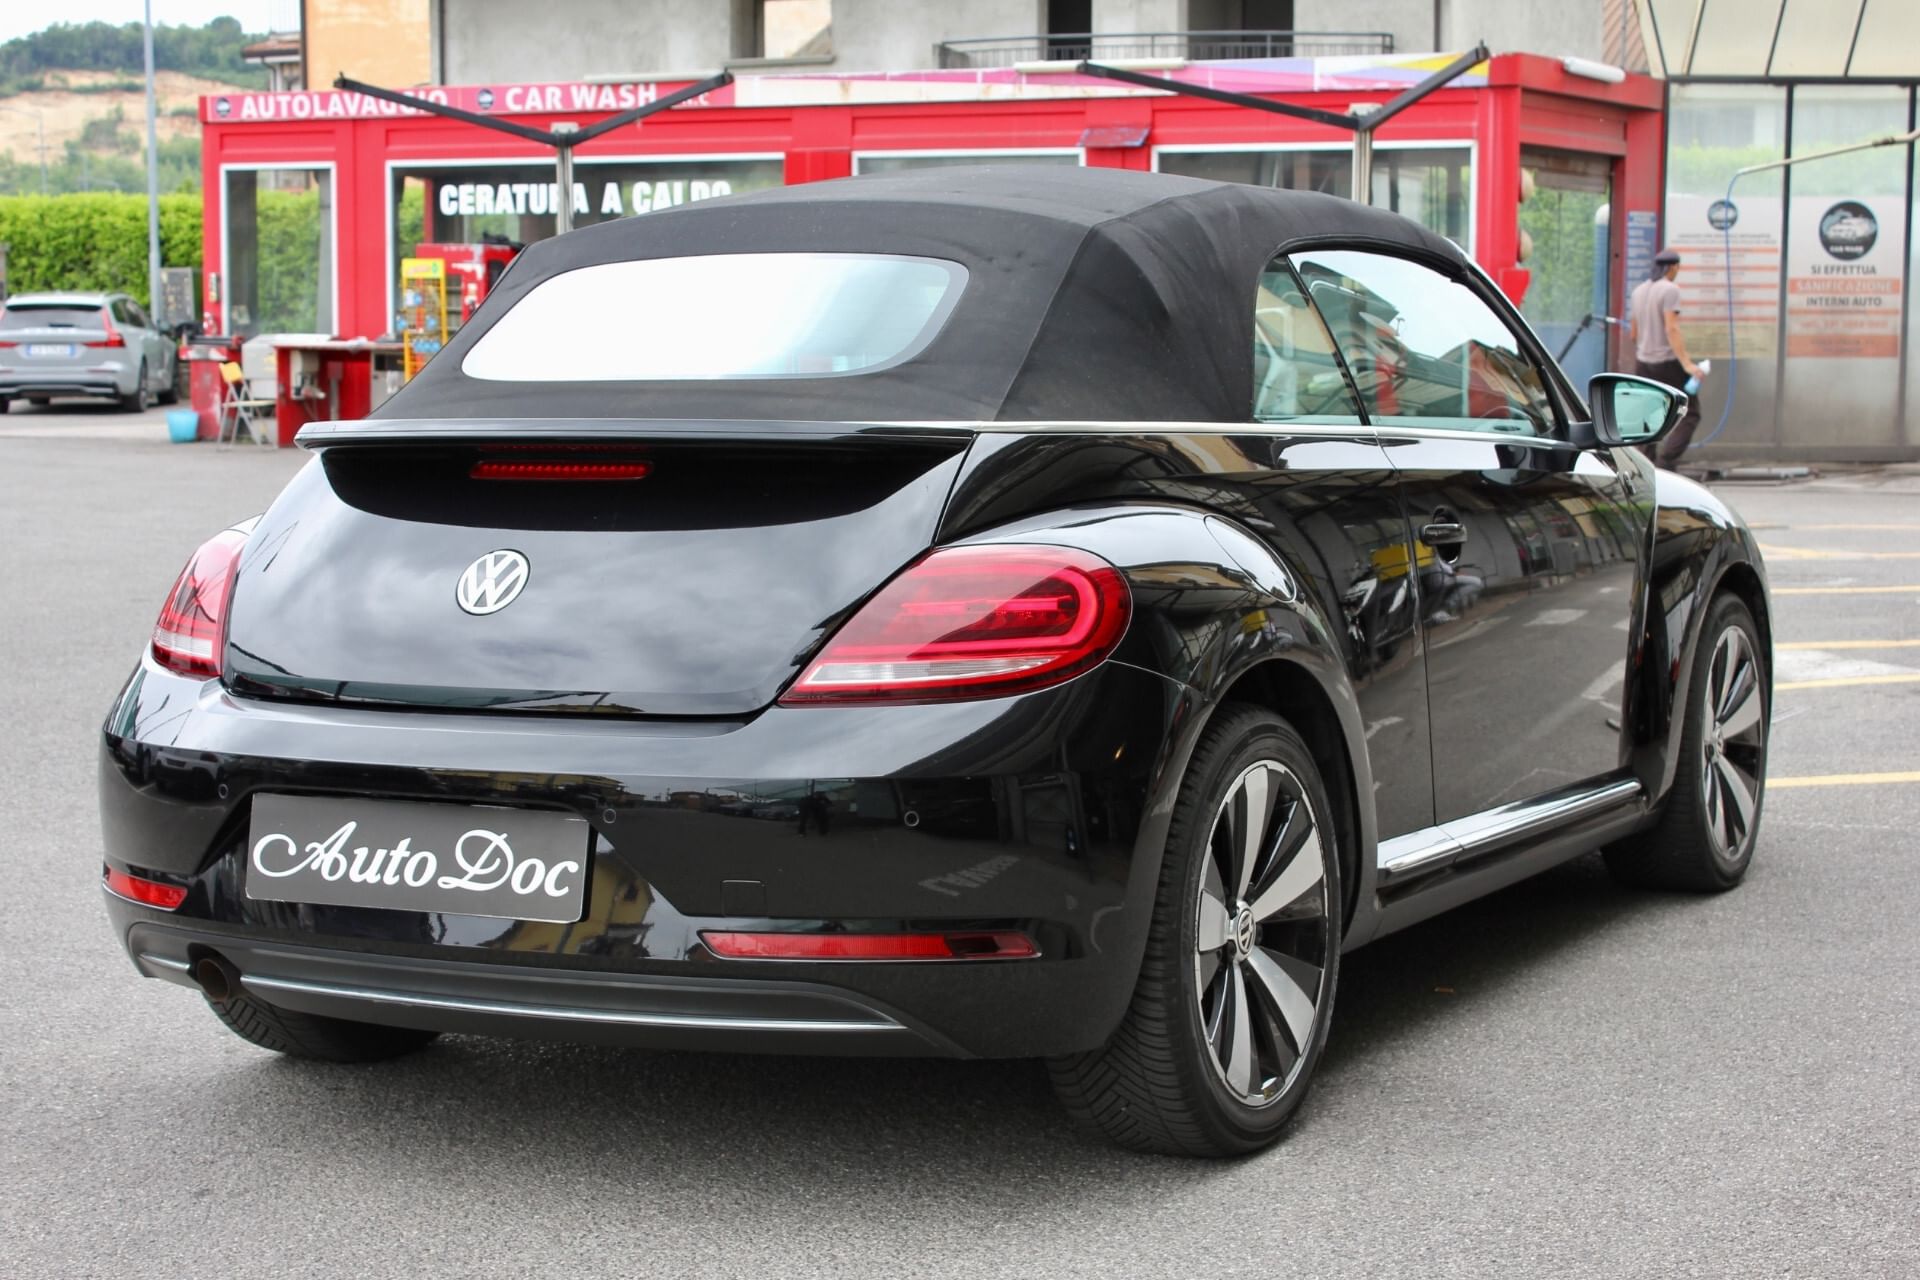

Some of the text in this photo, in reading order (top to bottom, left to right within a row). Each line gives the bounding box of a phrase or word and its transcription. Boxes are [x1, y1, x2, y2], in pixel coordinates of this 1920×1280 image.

[505, 86, 563, 112] CAR
[570, 83, 657, 110] WASH
[600, 182, 623, 214] A
[1810, 265, 1877, 275] SI EFFETTUA
[1796, 279, 1893, 293] SANIFICAZIONE
[1806, 296, 1882, 306] INTERNI AUTO
[253, 820, 579, 897] Auto Doc
